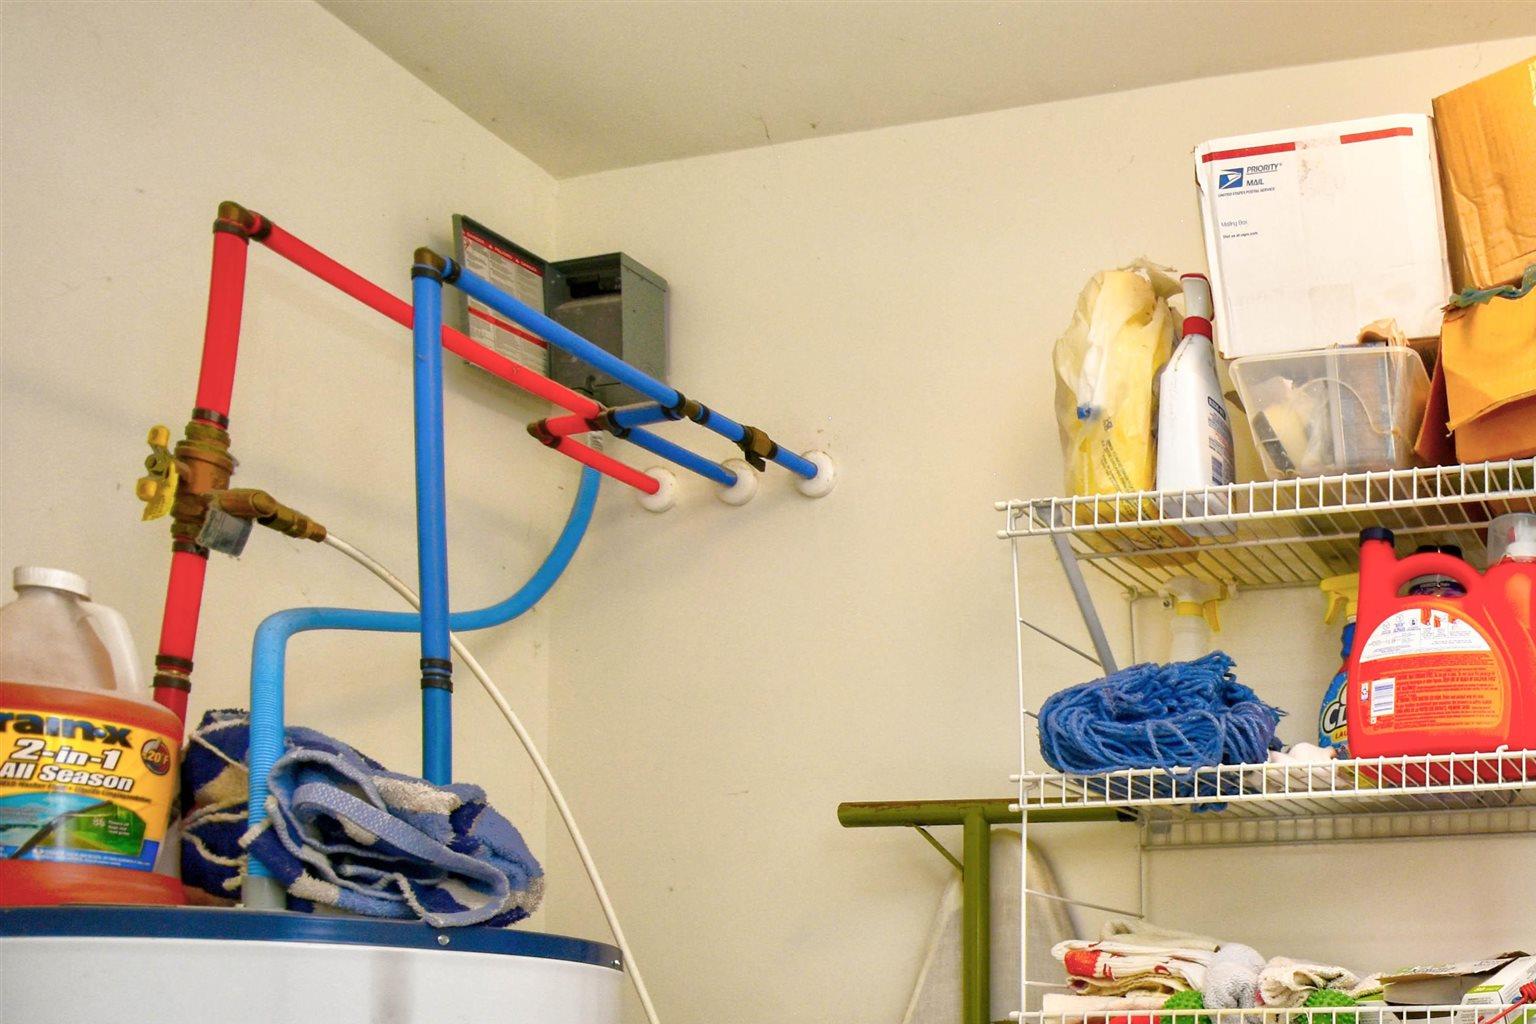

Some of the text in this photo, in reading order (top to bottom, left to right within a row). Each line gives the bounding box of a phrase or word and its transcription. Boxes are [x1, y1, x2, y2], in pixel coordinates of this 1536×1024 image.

[1246, 163, 1279, 173] PRIORITY
[9, 737, 123, 771] 2-in-1
[0, 761, 135, 793] All Season
